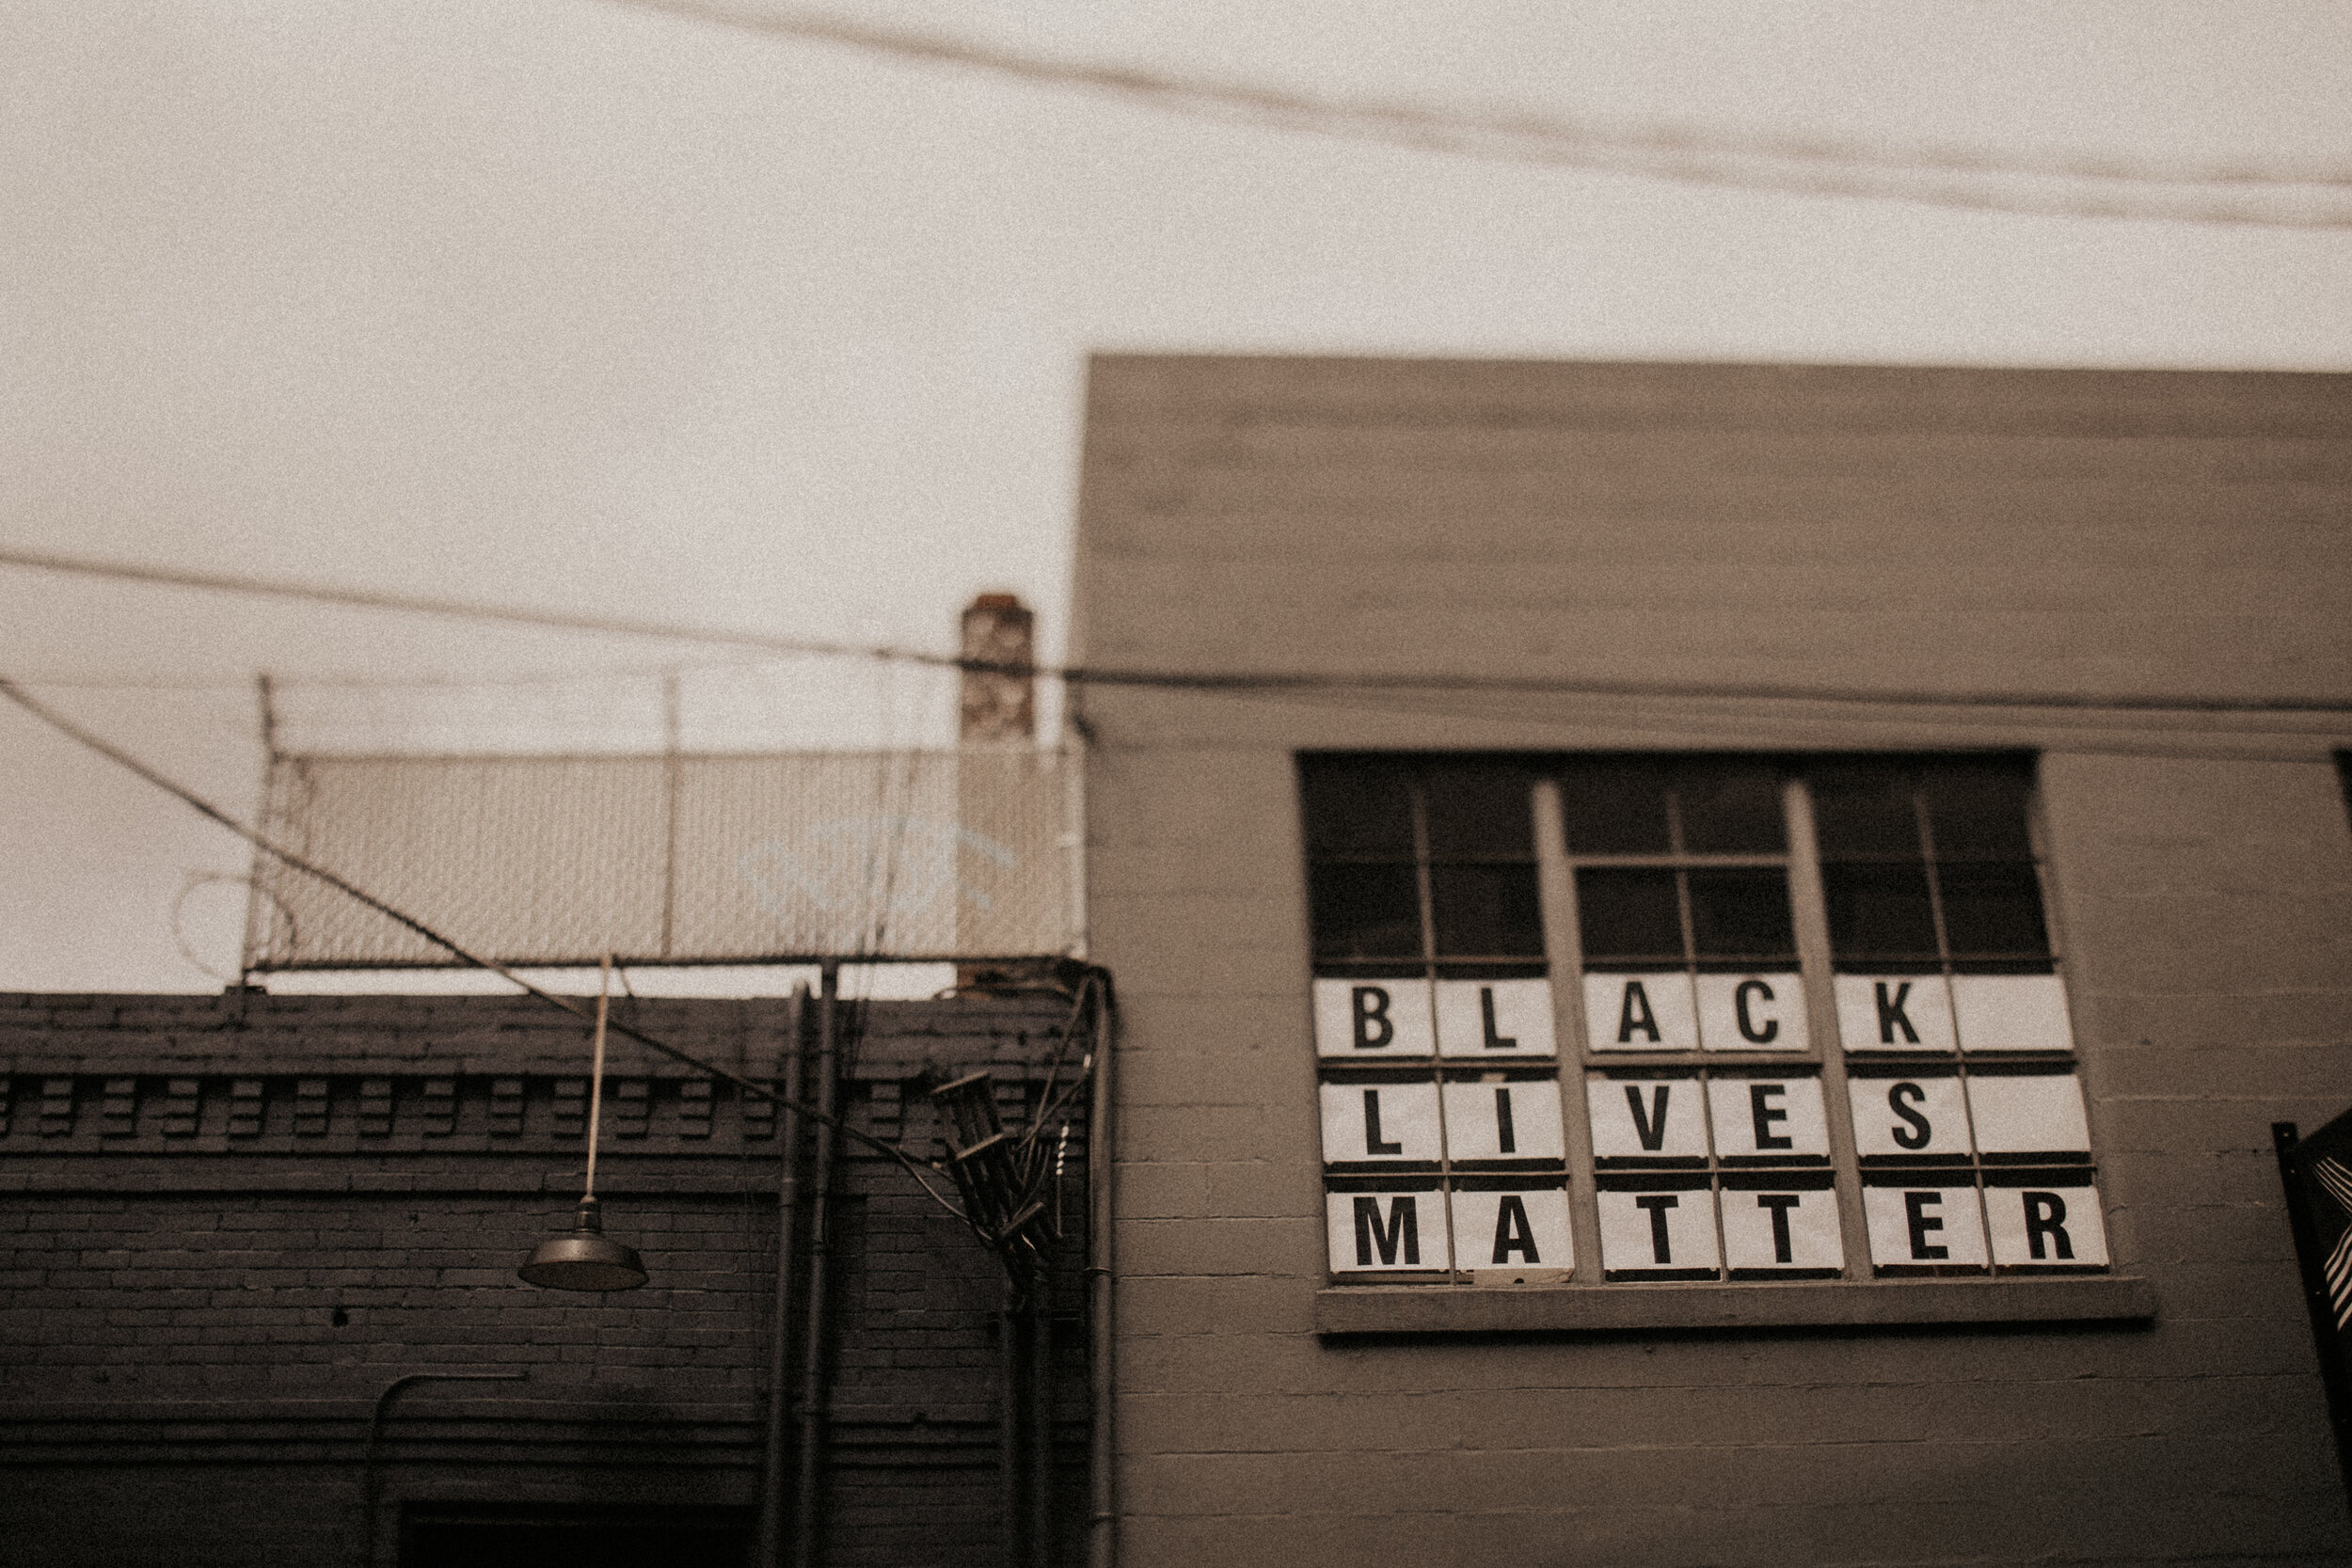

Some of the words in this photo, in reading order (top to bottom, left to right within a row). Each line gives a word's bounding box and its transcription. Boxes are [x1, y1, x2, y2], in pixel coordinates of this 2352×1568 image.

[1352, 980, 1921, 1049] BLACK
[1363, 1082, 1932, 1156] LIVES
[1353, 1191, 2074, 1266] MATTER
